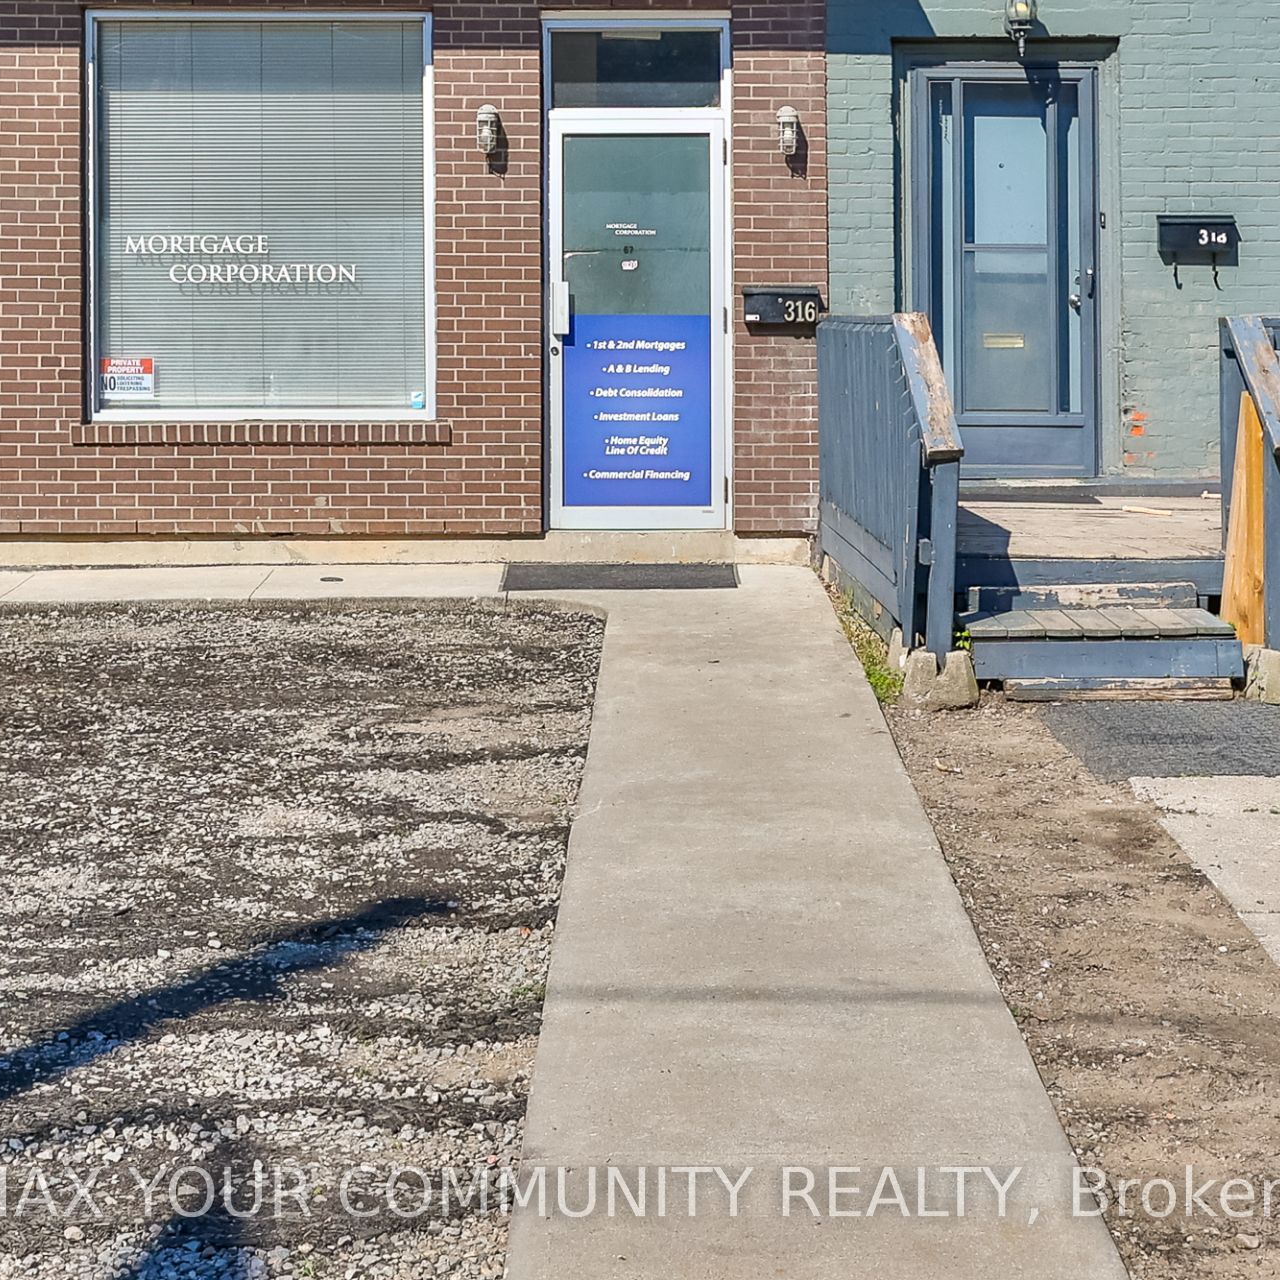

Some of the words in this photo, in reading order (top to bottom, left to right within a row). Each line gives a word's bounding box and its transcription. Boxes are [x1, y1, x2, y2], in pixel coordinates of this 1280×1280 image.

[124, 234, 269, 254] MORTGAGE
[169, 263, 357, 284] CORPORATION
[784, 300, 816, 322] 316
[593, 340, 607, 349] 1st
[608, 340, 615, 349] &
[616, 340, 635, 349] 2nd
[635, 340, 686, 351] Mortgages
[107, 366, 144, 374] PROPERTY
[607, 364, 615, 373] A
[616, 364, 624, 373] &
[625, 364, 632, 373] B
[633, 364, 670, 375] Lending
[101, 375, 116, 391] NO
[595, 388, 618, 397] Debt
[619, 388, 683, 397] Consolidation
[599, 412, 651, 421] Investment
[652, 412, 679, 421] Loans
[610, 436, 637, 444] Home
[638, 436, 668, 447] Equity
[606, 446, 625, 455] Line
[627, 446, 640, 455] Of
[639, 446, 668, 455] Credit
[588, 470, 644, 479] Commercial
[645, 470, 690, 481] Financing
